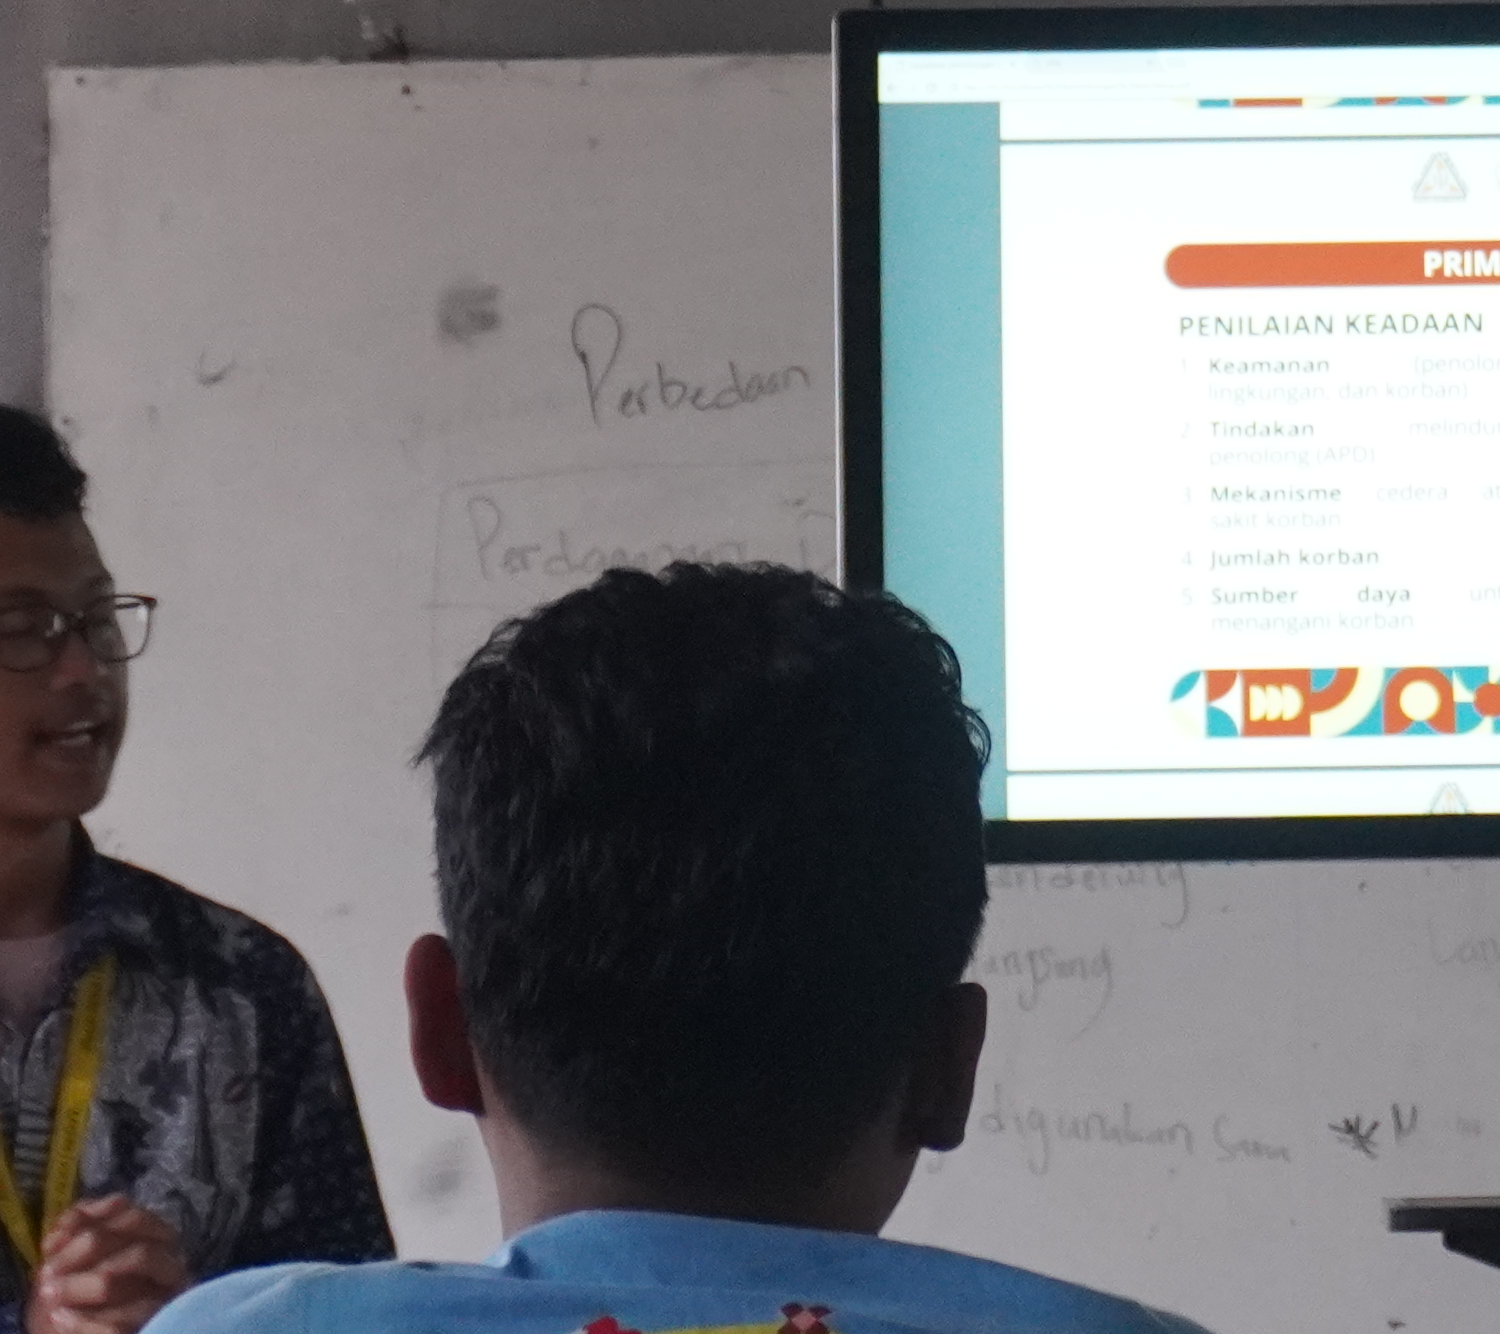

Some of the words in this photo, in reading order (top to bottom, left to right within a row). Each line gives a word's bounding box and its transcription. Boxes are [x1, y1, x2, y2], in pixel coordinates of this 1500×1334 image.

[1178, 314, 1334, 338] PENILAIAN
[1344, 312, 1485, 336] KEADAAN
[1208, 357, 1331, 375] Keamanan
[1338, 381, 1379, 401] dan
[1209, 420, 1316, 439] Tindakan
[1208, 445, 1311, 470] penolong
[1209, 484, 1342, 504] Mekanisme
[1376, 483, 1449, 503] cedera
[1209, 511, 1259, 531] sakit
[1264, 510, 1342, 530] korban
[1208, 548, 1291, 571] Jumlah
[1298, 547, 1380, 567] korban
[1210, 586, 1299, 605] Sumber
[1356, 585, 1412, 607] daya
[1210, 613, 1332, 635] menangani
[1338, 610, 1416, 630] korban
